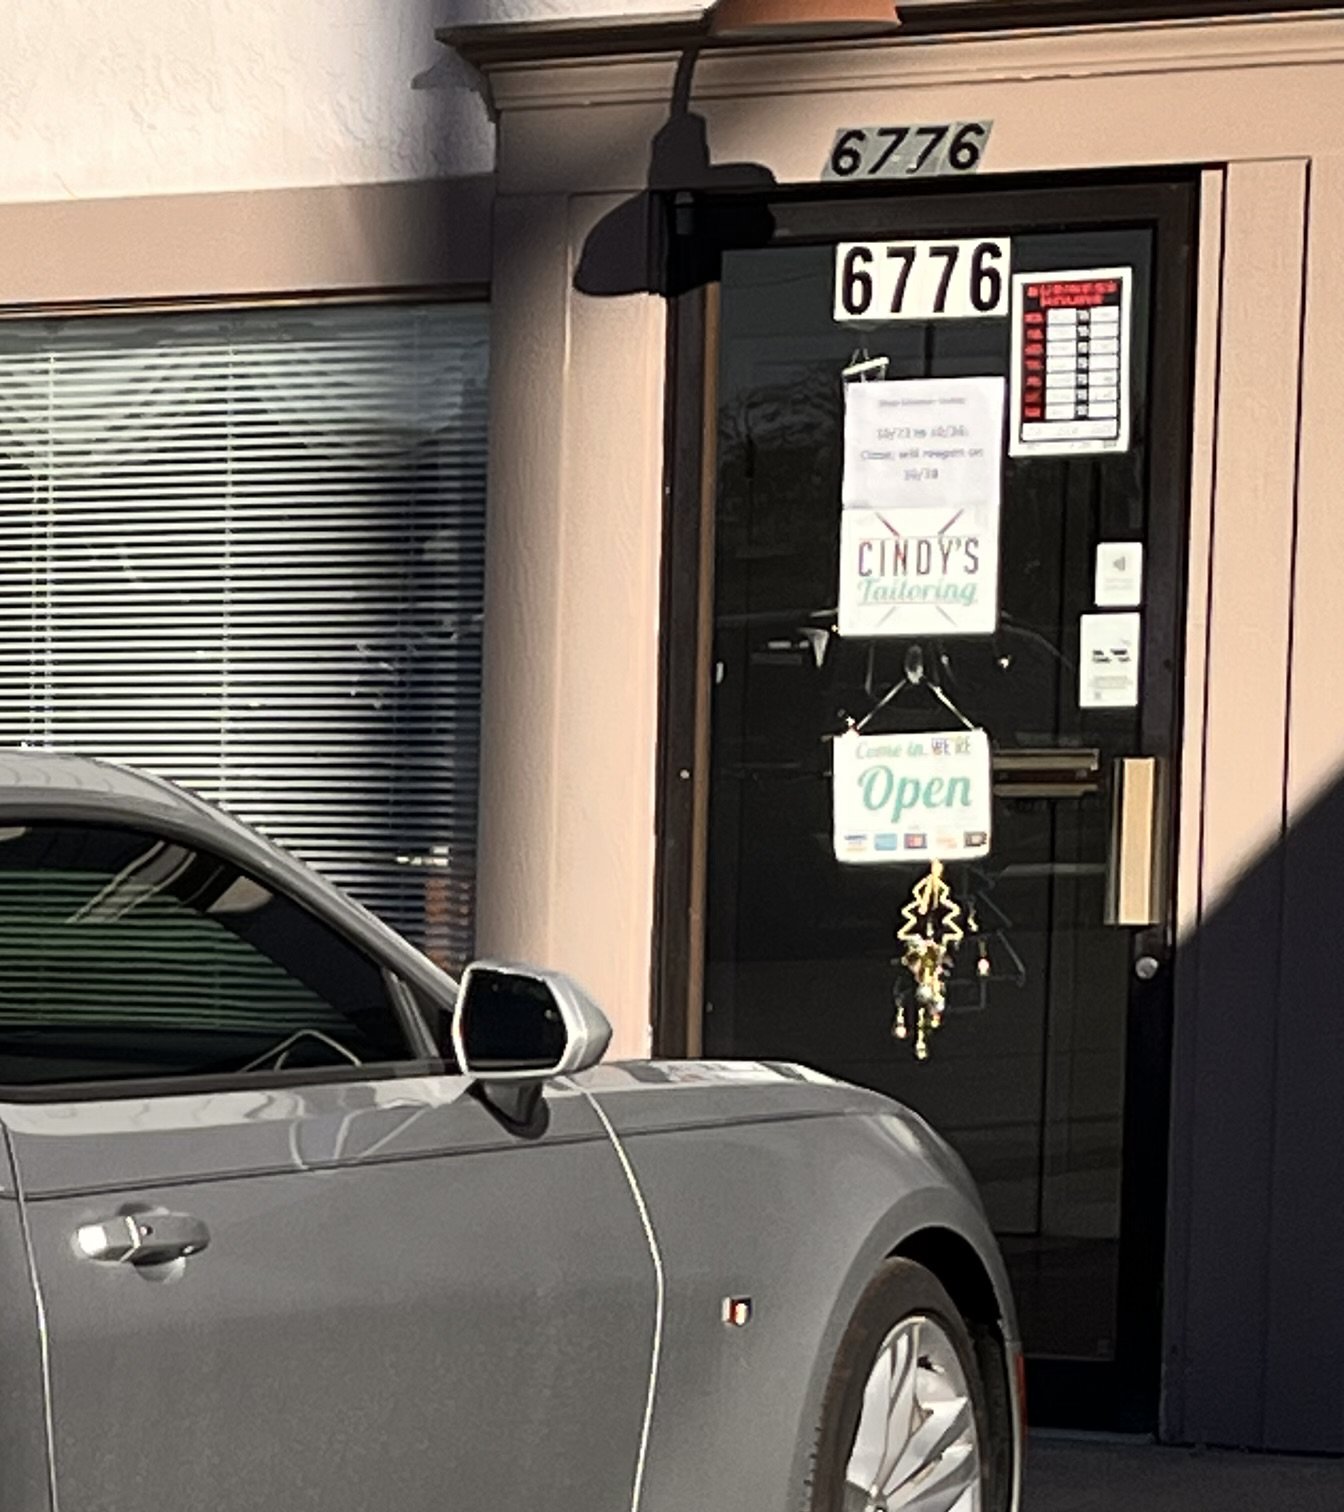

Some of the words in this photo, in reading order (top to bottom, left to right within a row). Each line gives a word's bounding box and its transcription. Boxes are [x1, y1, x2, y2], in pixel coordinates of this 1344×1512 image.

[831, 122, 986, 177] 6776
[841, 242, 1003, 316] 6776
[858, 537, 979, 577] CINDY'S
[857, 577, 978, 607] Tailoring
[857, 764, 972, 824] Open
